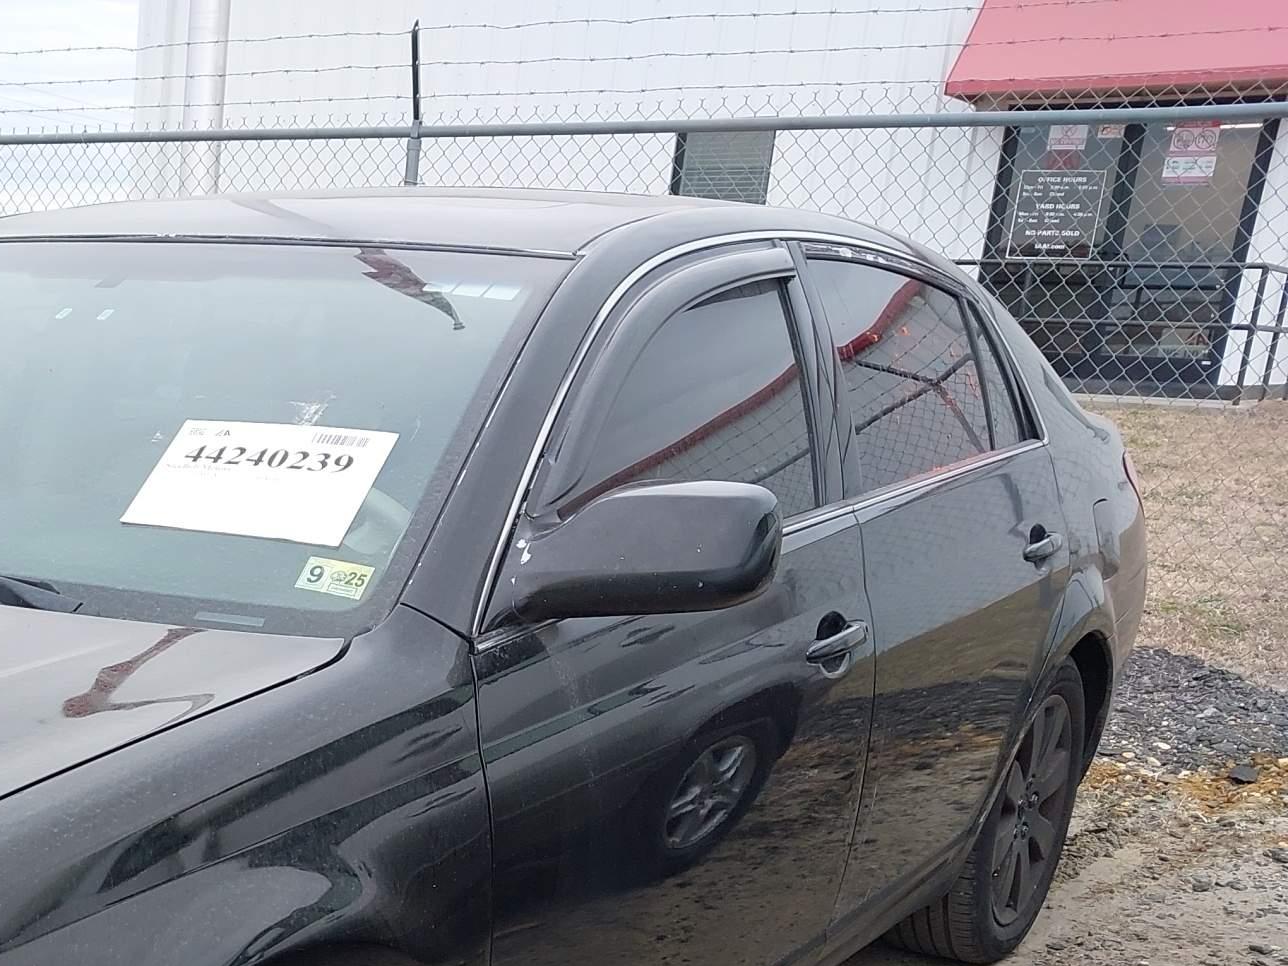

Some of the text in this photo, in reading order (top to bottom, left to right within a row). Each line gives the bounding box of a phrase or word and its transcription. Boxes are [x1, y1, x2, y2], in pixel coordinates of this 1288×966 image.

[184, 444, 355, 474] 44240239
[306, 565, 368, 588] 9 25
